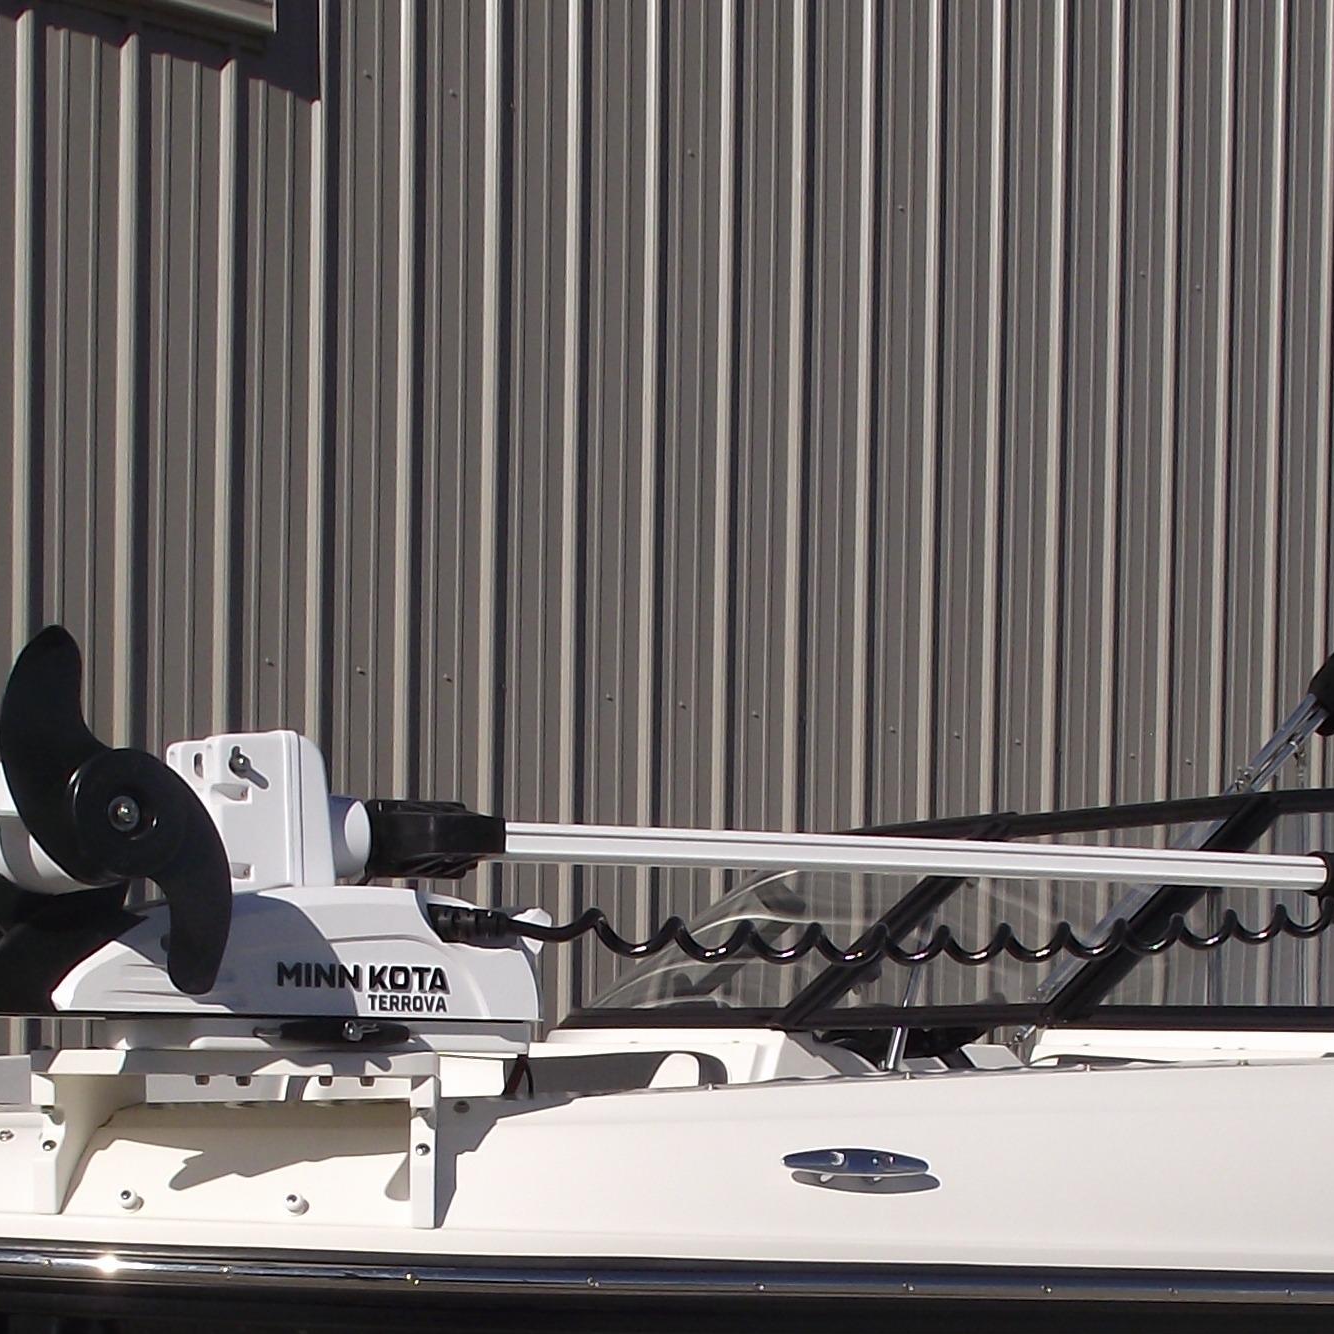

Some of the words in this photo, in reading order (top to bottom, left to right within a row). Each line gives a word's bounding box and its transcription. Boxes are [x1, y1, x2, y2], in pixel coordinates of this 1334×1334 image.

[276, 961, 362, 991] MINN
[368, 964, 450, 994] KOTA
[368, 994, 448, 1013] TERROVA
